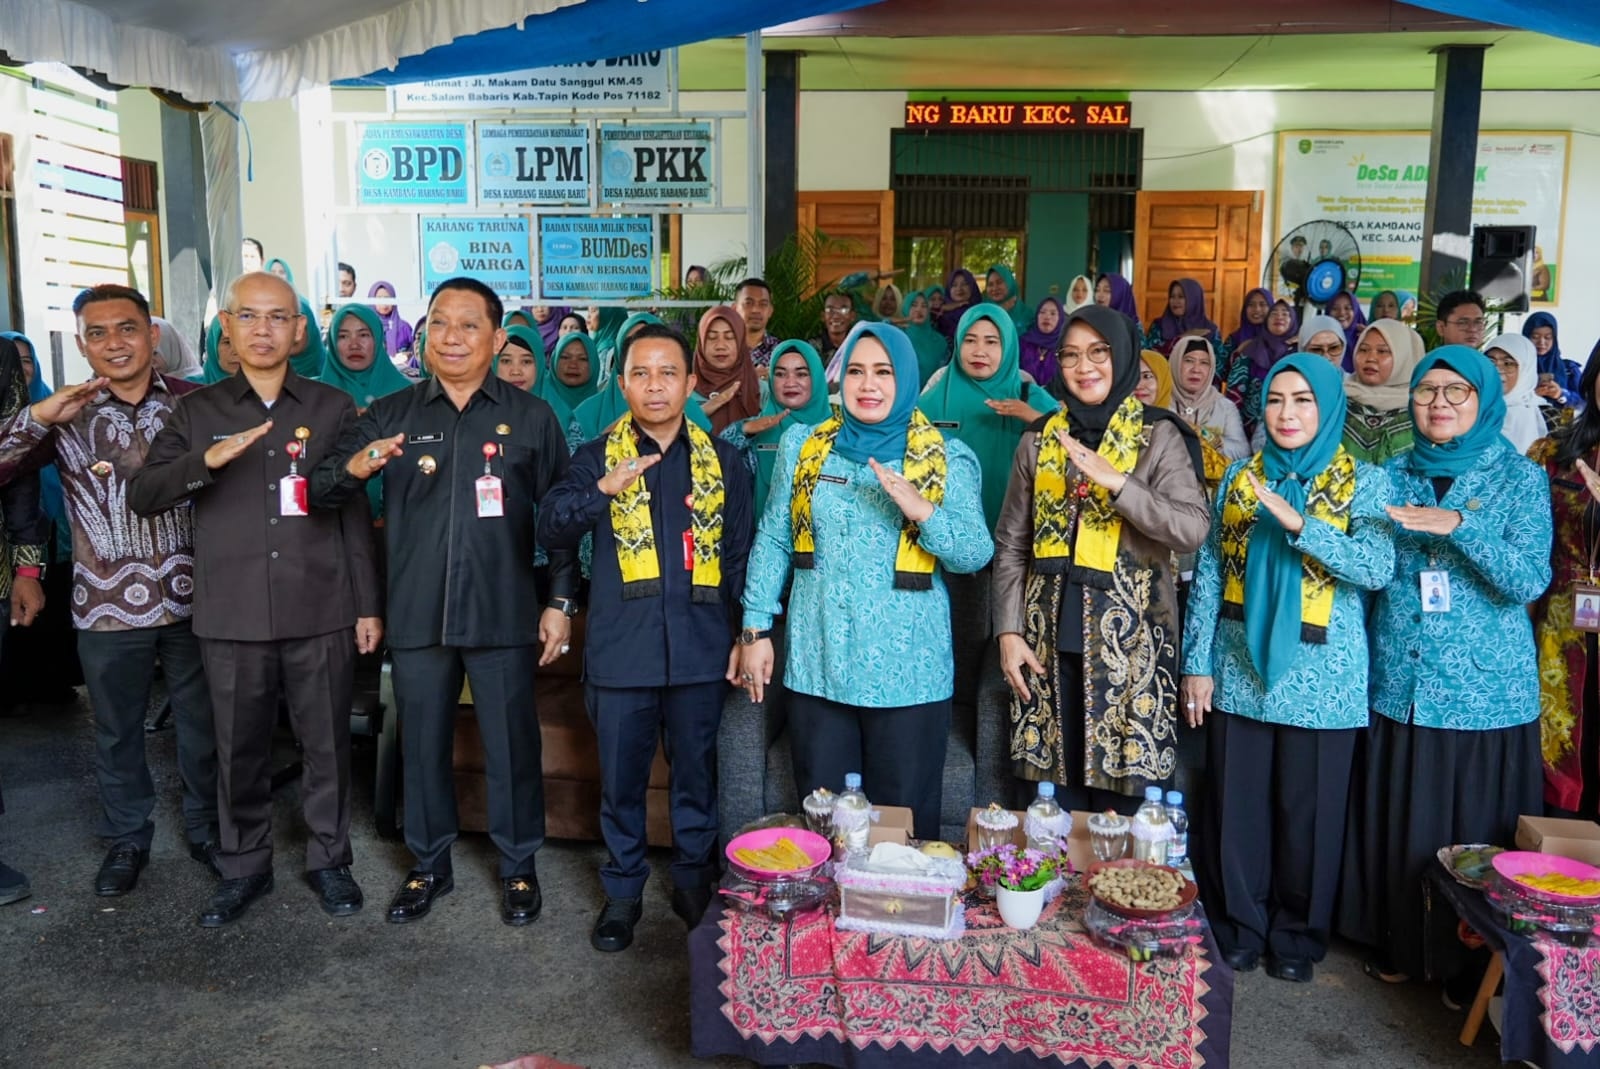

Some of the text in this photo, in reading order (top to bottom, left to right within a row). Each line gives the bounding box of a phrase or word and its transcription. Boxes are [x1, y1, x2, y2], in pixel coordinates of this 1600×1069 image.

[488, 79, 528, 87] Makam
[531, 78, 556, 87] Datu
[560, 77, 605, 88] Sanggul
[608, 77, 644, 86] KM.45
[468, 93, 509, 101] Babaris
[572, 92, 600, 100] Kode
[604, 91, 623, 100] Pos
[626, 91, 662, 100] 71182
[906, 105, 1129, 124] NG BARU KEC. SAL
[391, 146, 463, 181] BPD
[515, 146, 584, 182] LPM
[633, 146, 708, 183] PKK
[1356, 164, 1399, 181] DeSa
[483, 189, 502, 199] DESA
[503, 189, 537, 199] KAMBANG
[604, 188, 623, 198] DESA
[624, 188, 658, 198] KAMBANG
[427, 222, 525, 232] KARANG TARUNA
[545, 223, 648, 233] BADAN USAHA MILIK DESA
[1367, 222, 1421, 231] KAMBANG
[469, 241, 513, 254] BINA
[581, 237, 648, 259] BUMDes
[461, 258, 525, 271] WARGA
[546, 265, 648, 275] HARAPAN BERSAMA
